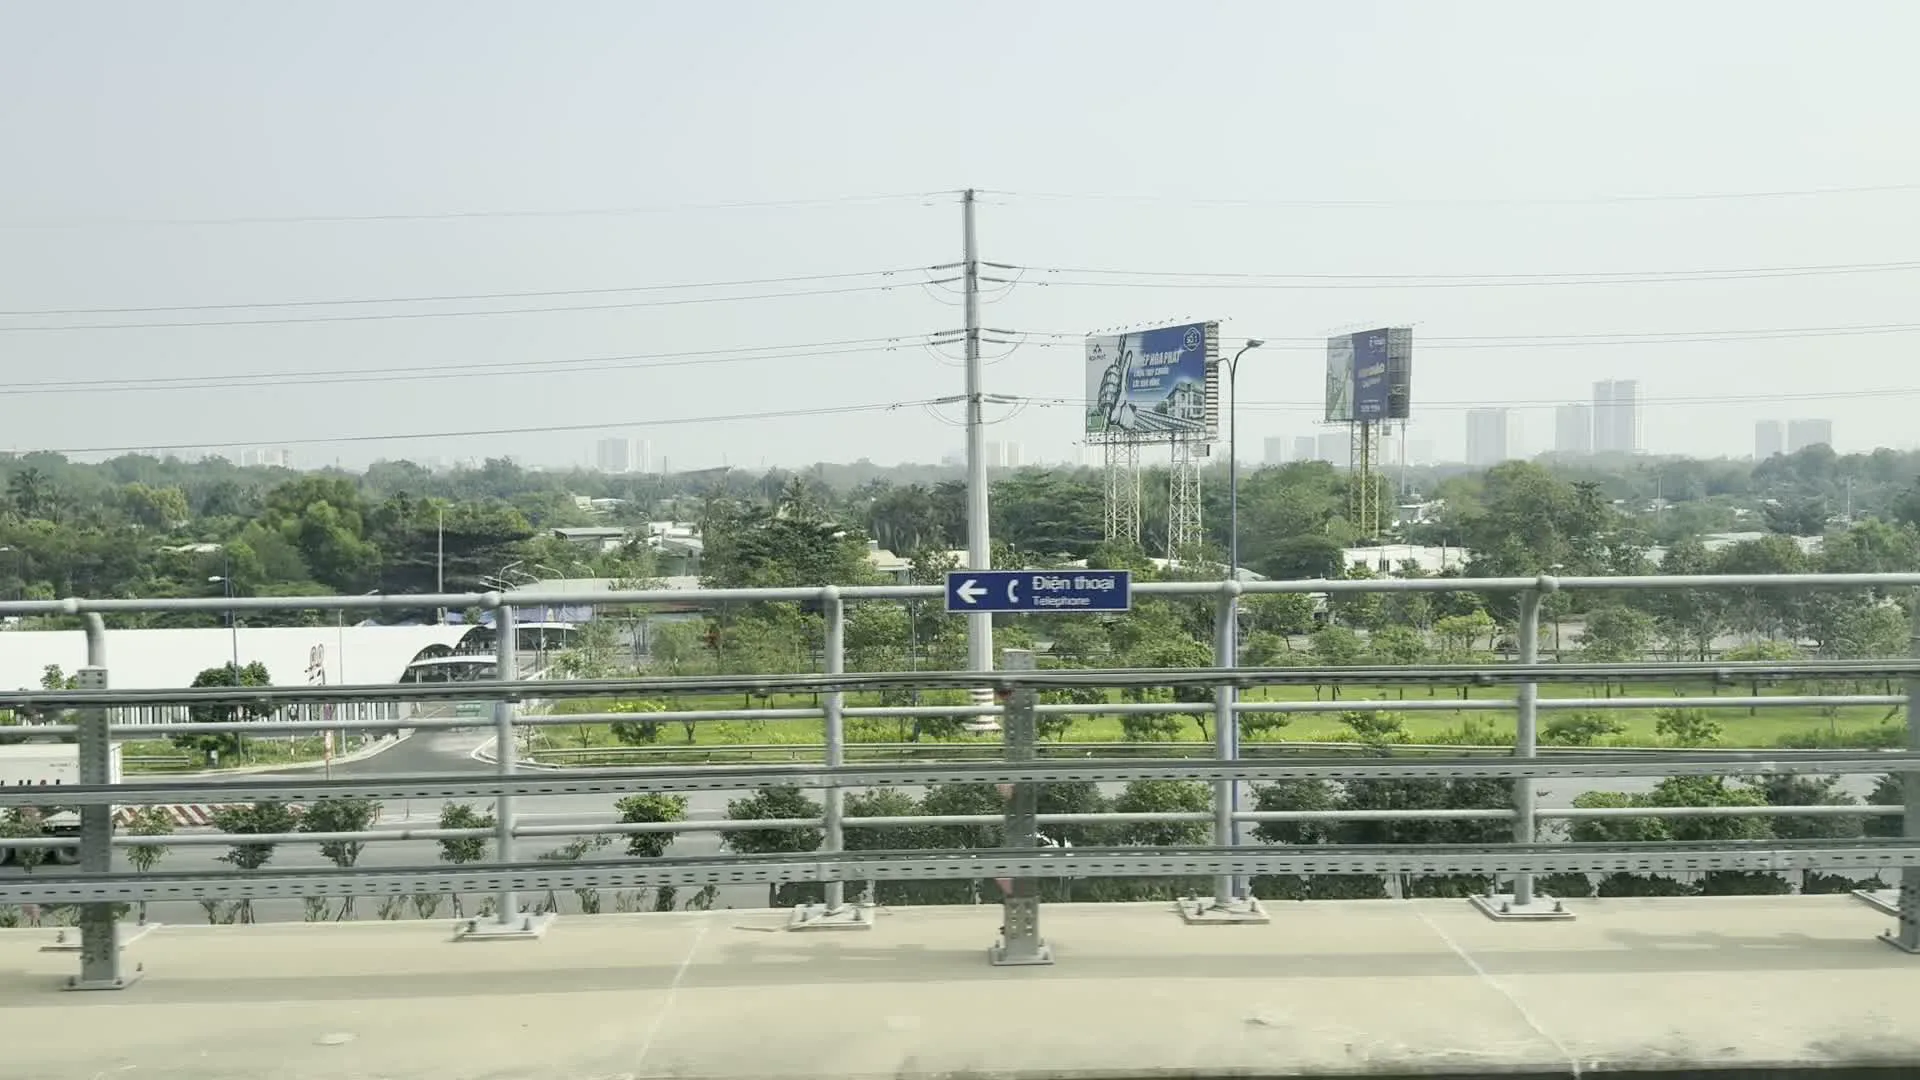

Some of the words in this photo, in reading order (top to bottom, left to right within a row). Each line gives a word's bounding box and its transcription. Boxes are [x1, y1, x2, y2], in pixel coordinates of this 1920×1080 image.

[1032, 576, 1070, 592] Điện
[1074, 576, 1115, 592] thoại
[1032, 596, 1091, 607] Telephone
